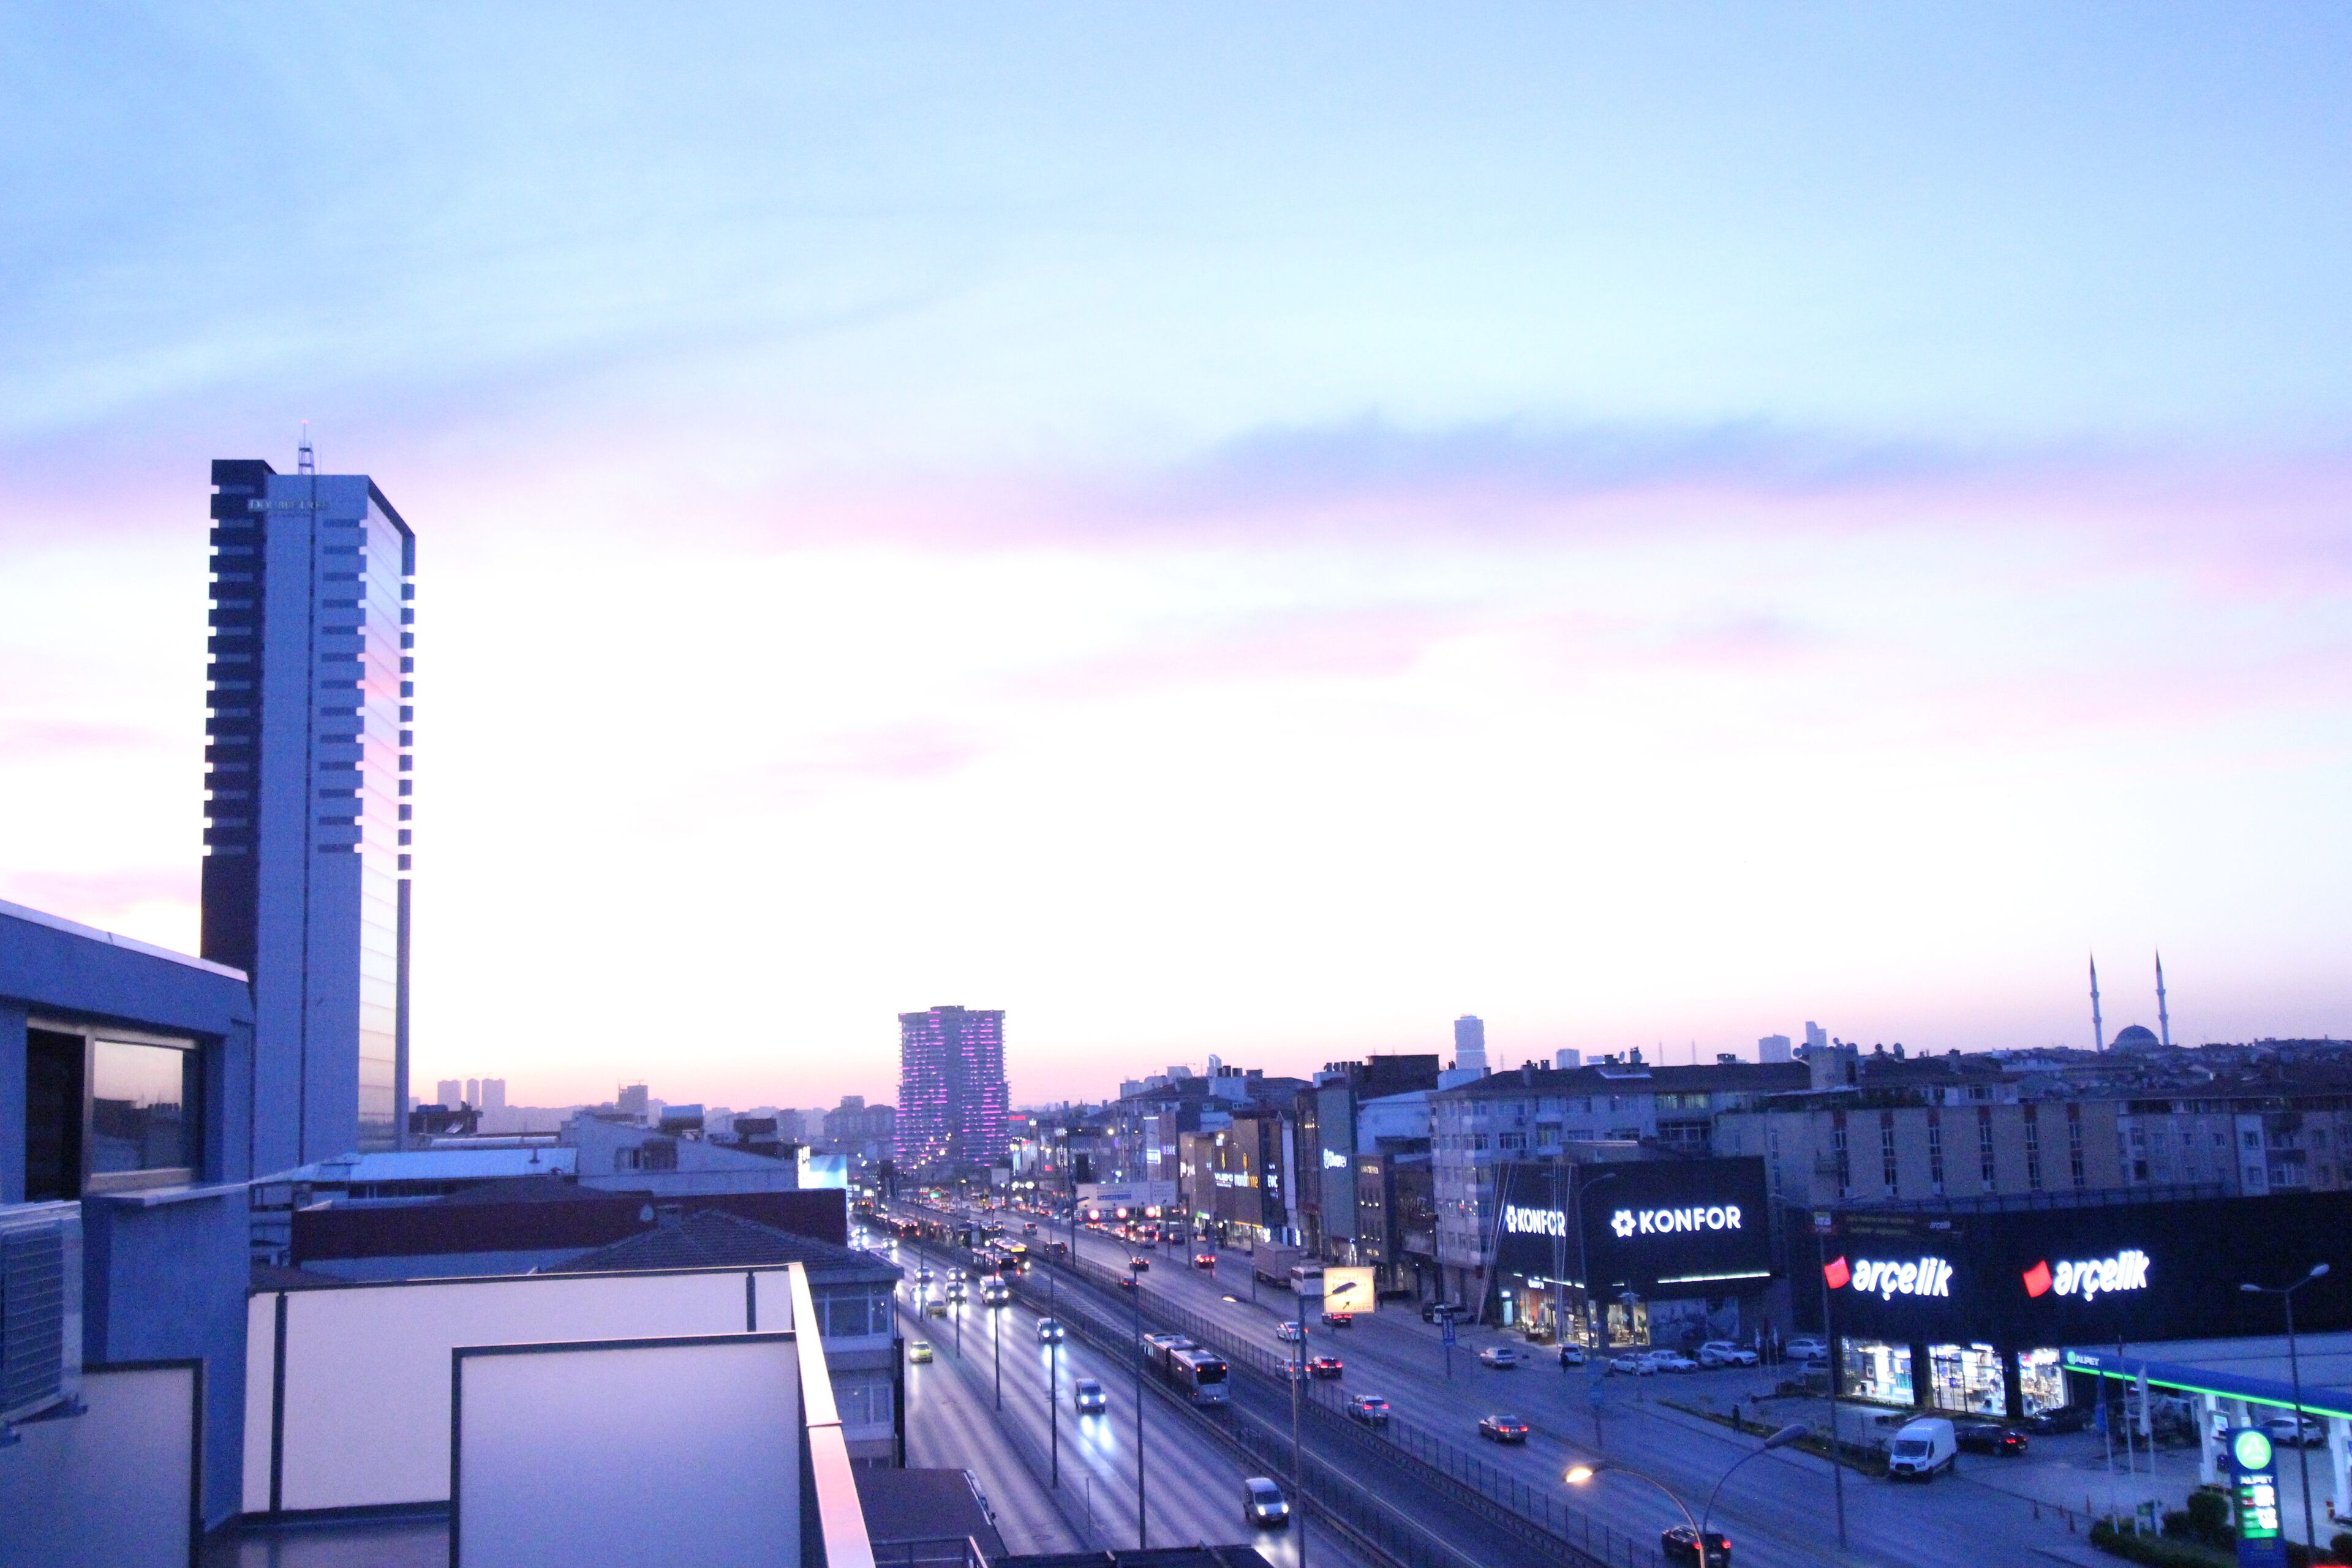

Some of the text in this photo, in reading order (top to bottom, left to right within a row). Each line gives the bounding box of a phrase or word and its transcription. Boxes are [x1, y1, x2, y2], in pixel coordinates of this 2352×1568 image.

[1517, 1208, 1566, 1237] KONFOR
[1639, 1205, 1741, 1234] KONFOR
[1852, 1257, 1953, 1301] arçelik
[2054, 1250, 2150, 1302] arçelik
[2075, 1355, 2100, 1366] ALPET
[2240, 1476, 2273, 1485] ALPET
